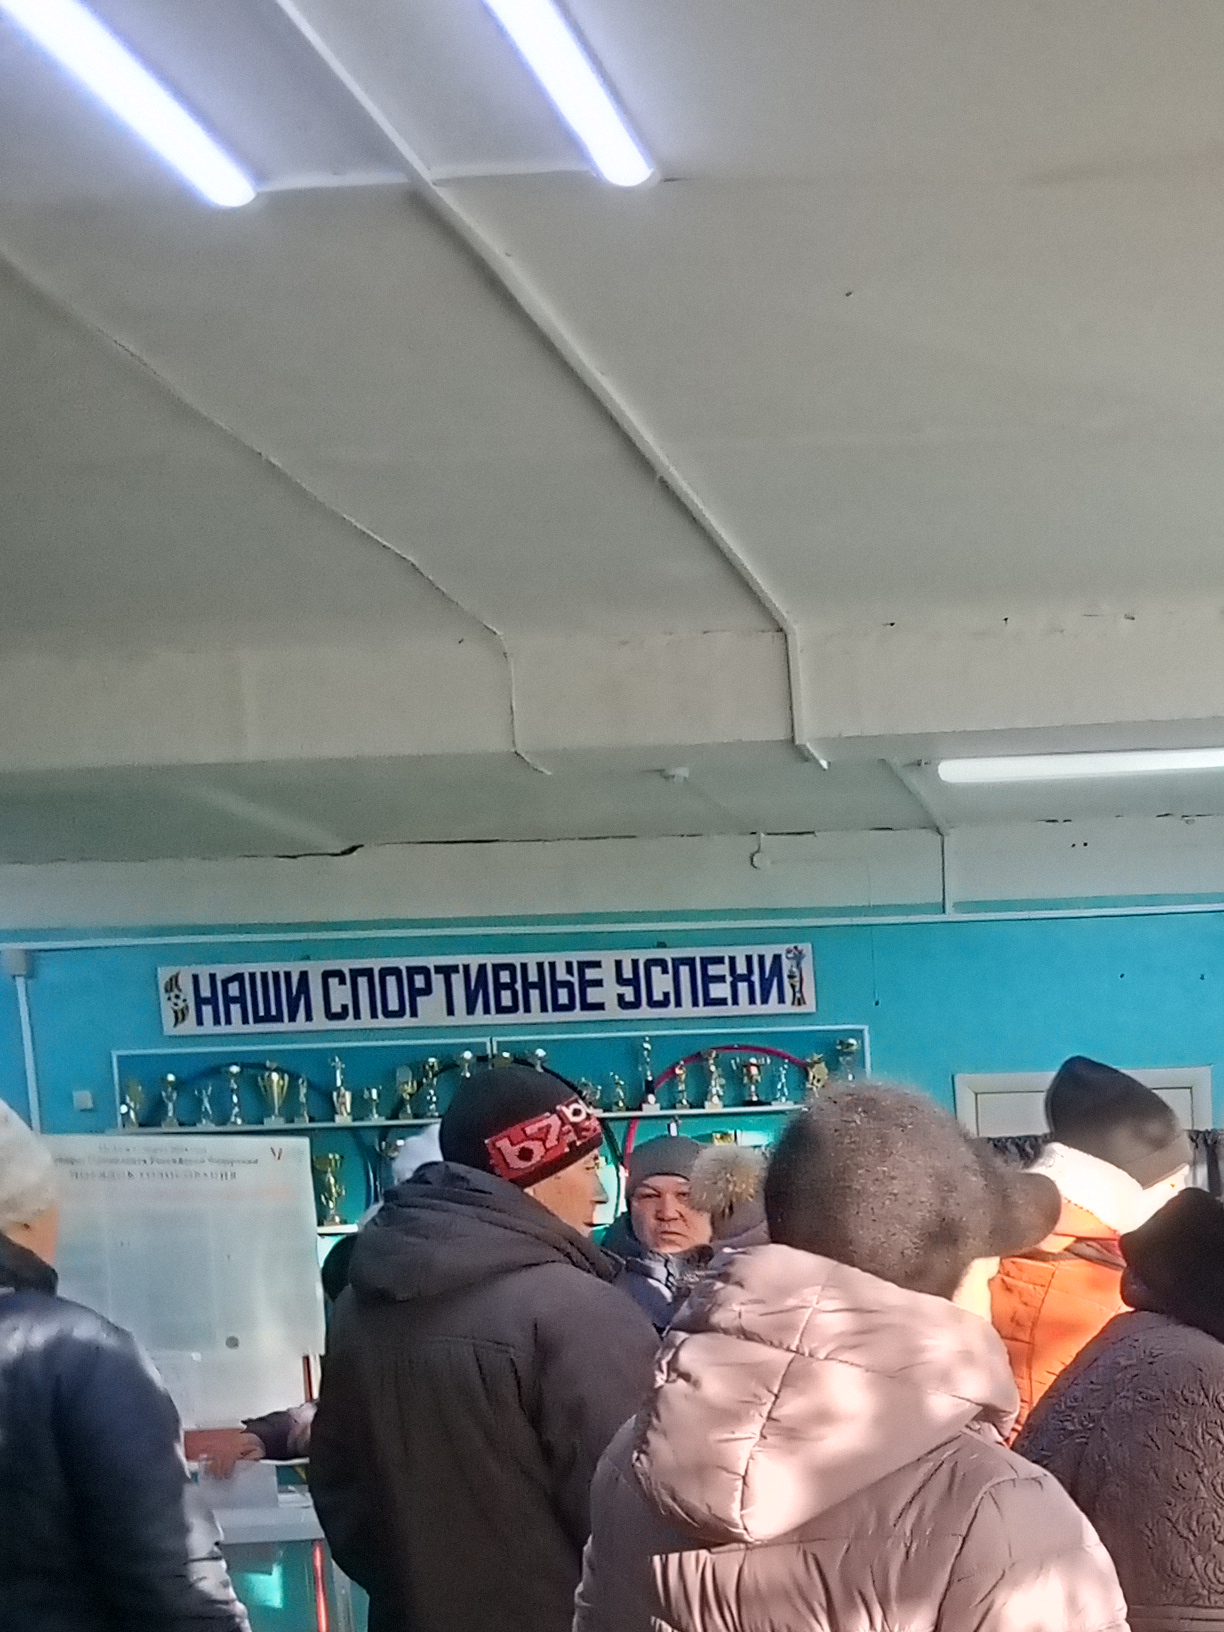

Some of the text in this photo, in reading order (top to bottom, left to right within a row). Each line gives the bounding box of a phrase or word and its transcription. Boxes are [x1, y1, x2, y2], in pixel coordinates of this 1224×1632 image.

[192, 953, 787, 1027] НАШИ СПОРТИВНЫЕ УСПЕХИ
